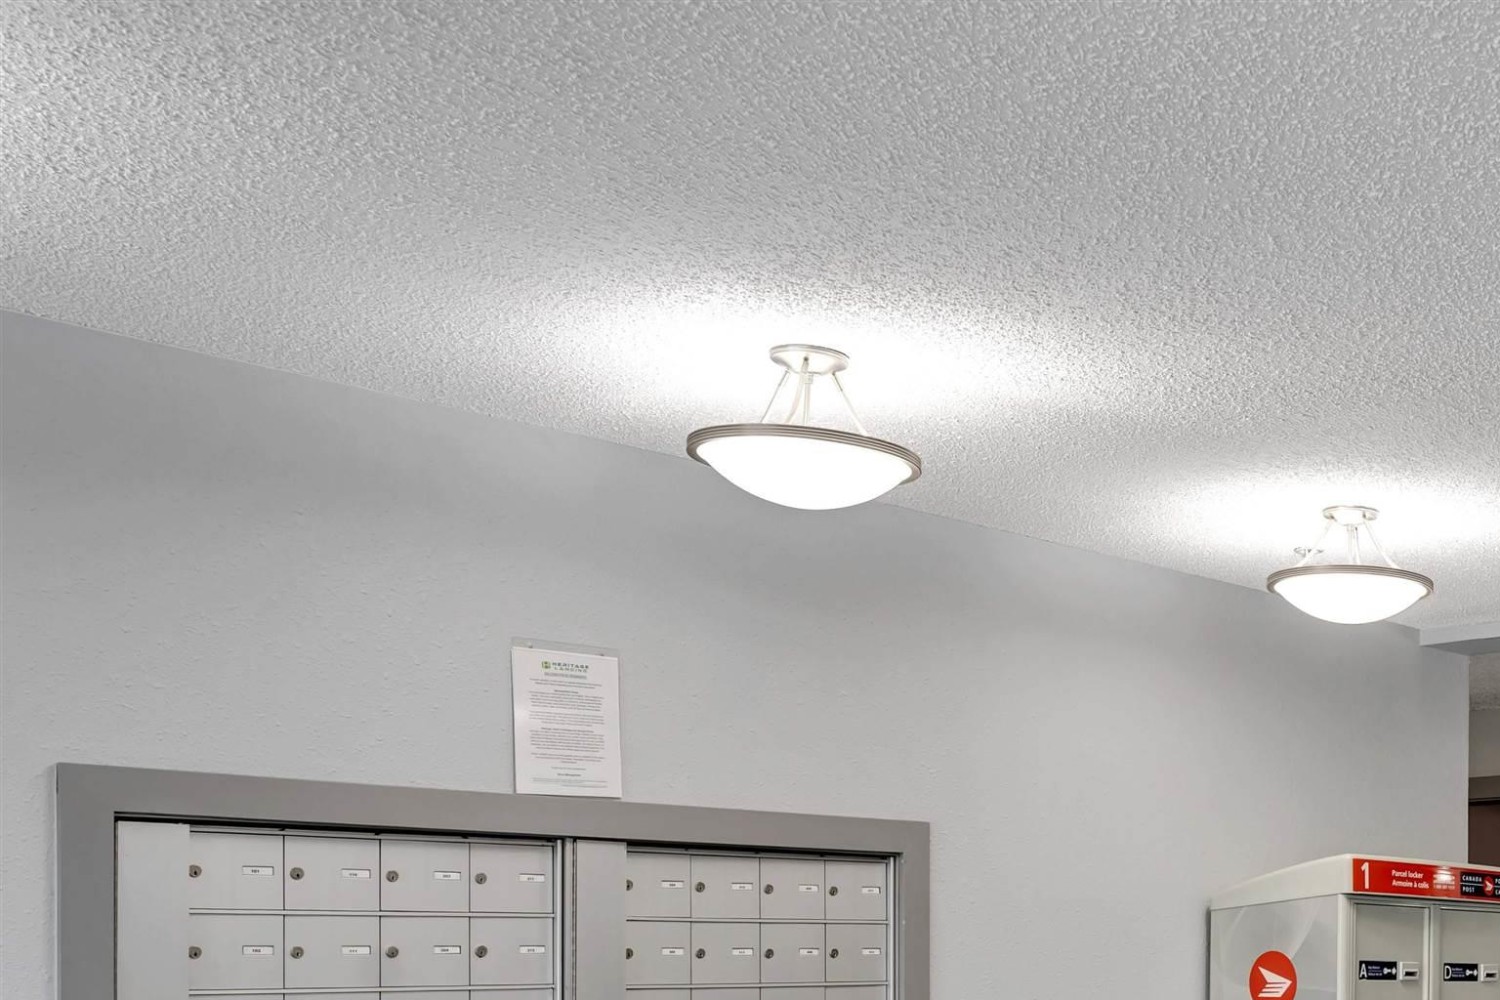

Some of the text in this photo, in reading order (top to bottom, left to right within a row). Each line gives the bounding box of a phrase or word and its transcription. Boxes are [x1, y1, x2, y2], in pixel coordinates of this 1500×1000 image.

[1361, 862, 1370, 890] 1
[1359, 963, 1368, 978] A
[1444, 965, 1452, 979] D
